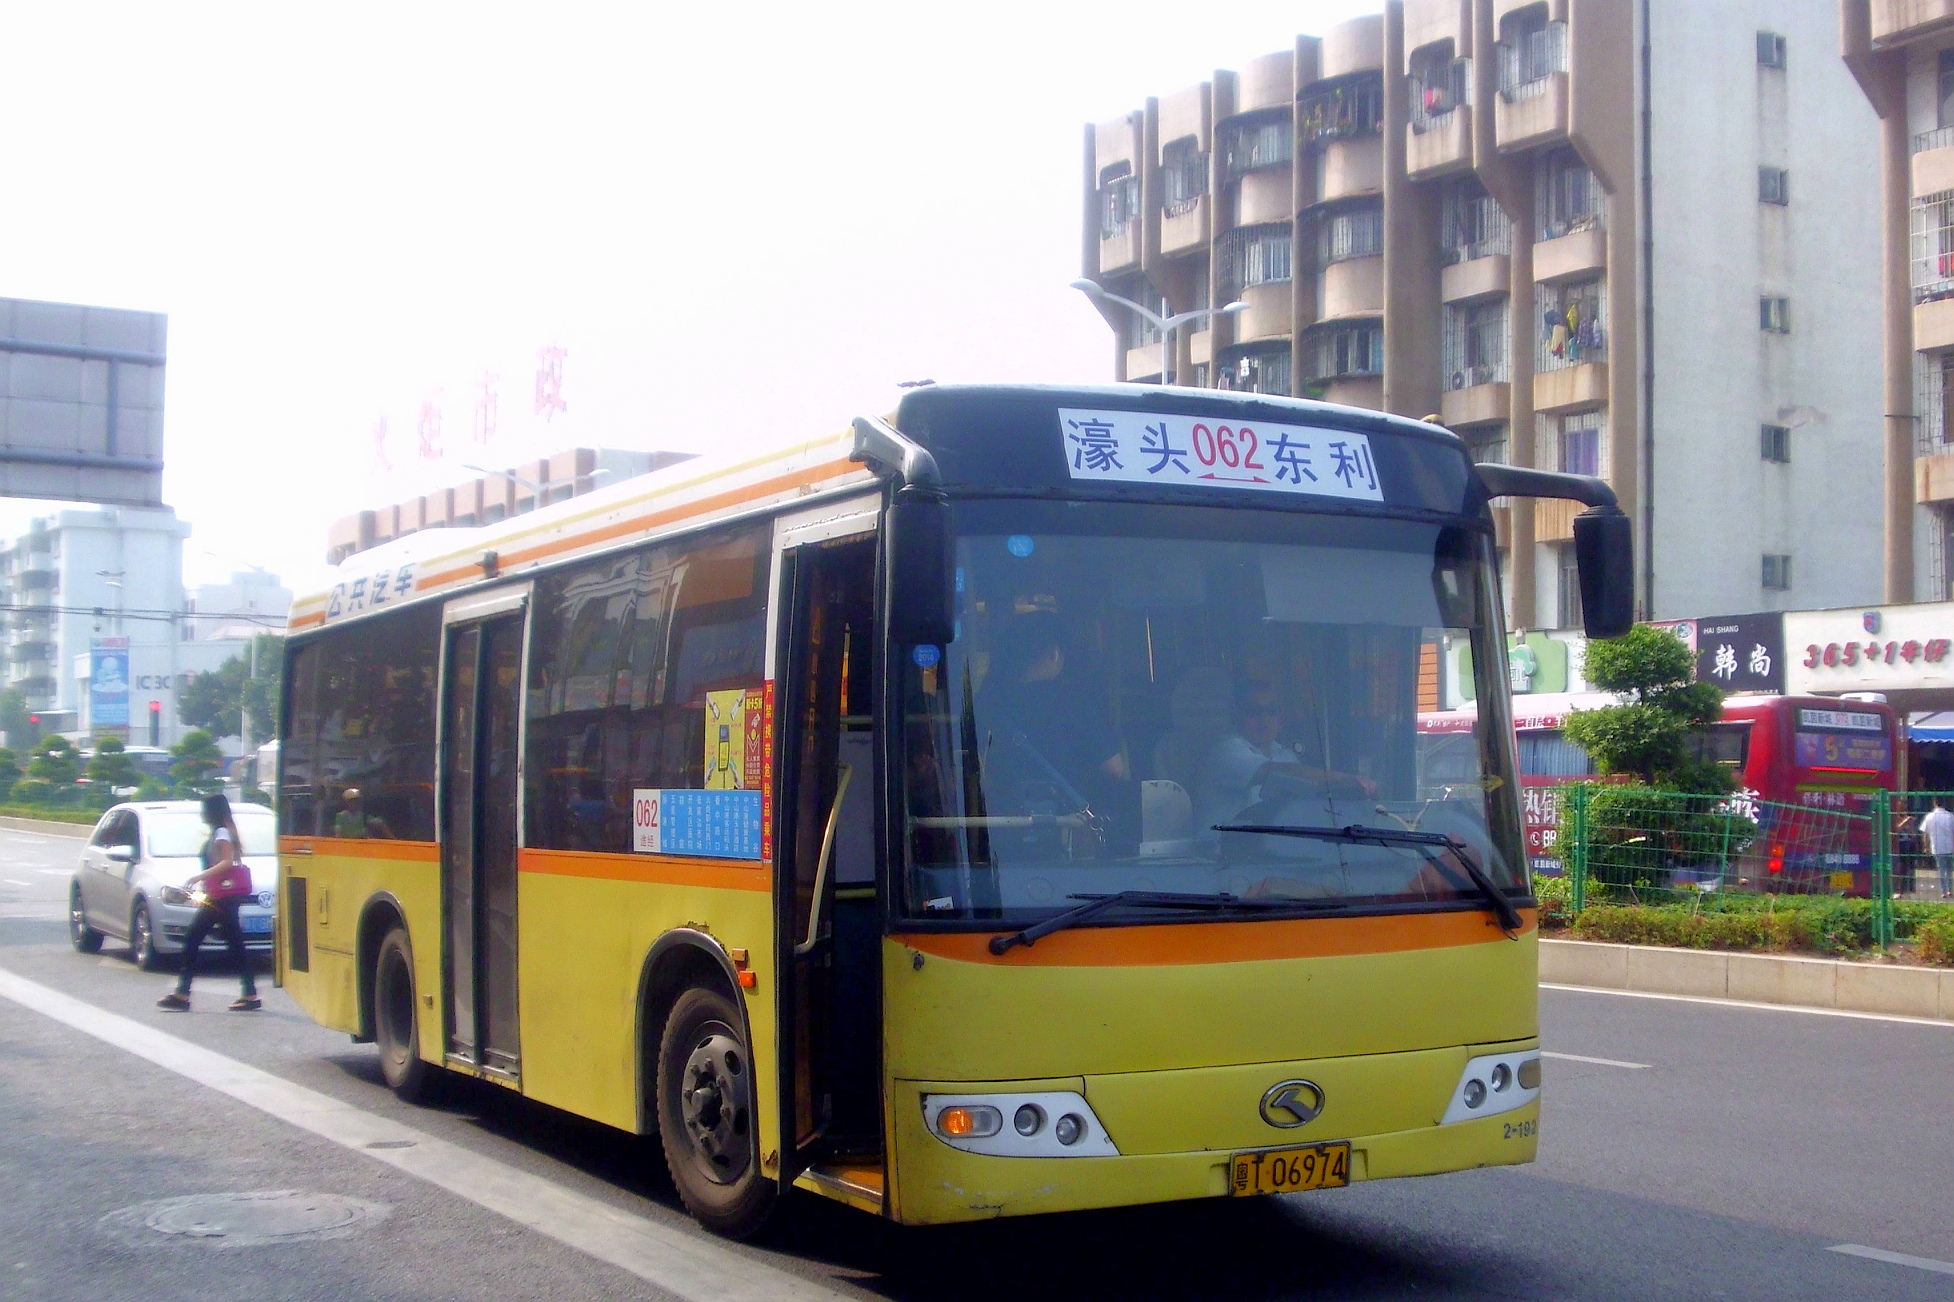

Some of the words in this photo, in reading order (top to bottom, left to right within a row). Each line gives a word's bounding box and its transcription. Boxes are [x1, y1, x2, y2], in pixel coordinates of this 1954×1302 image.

[1067, 417, 1191, 475] 濠头
[1192, 422, 1264, 470] 062
[1265, 433, 1377, 491] 东利
[327, 562, 416, 617] 公共汽车
[1703, 627, 1715, 635] HAI
[1716, 625, 1739, 634] SHANG
[1712, 642, 1772, 681] 韩尚
[636, 799, 657, 828] 062
